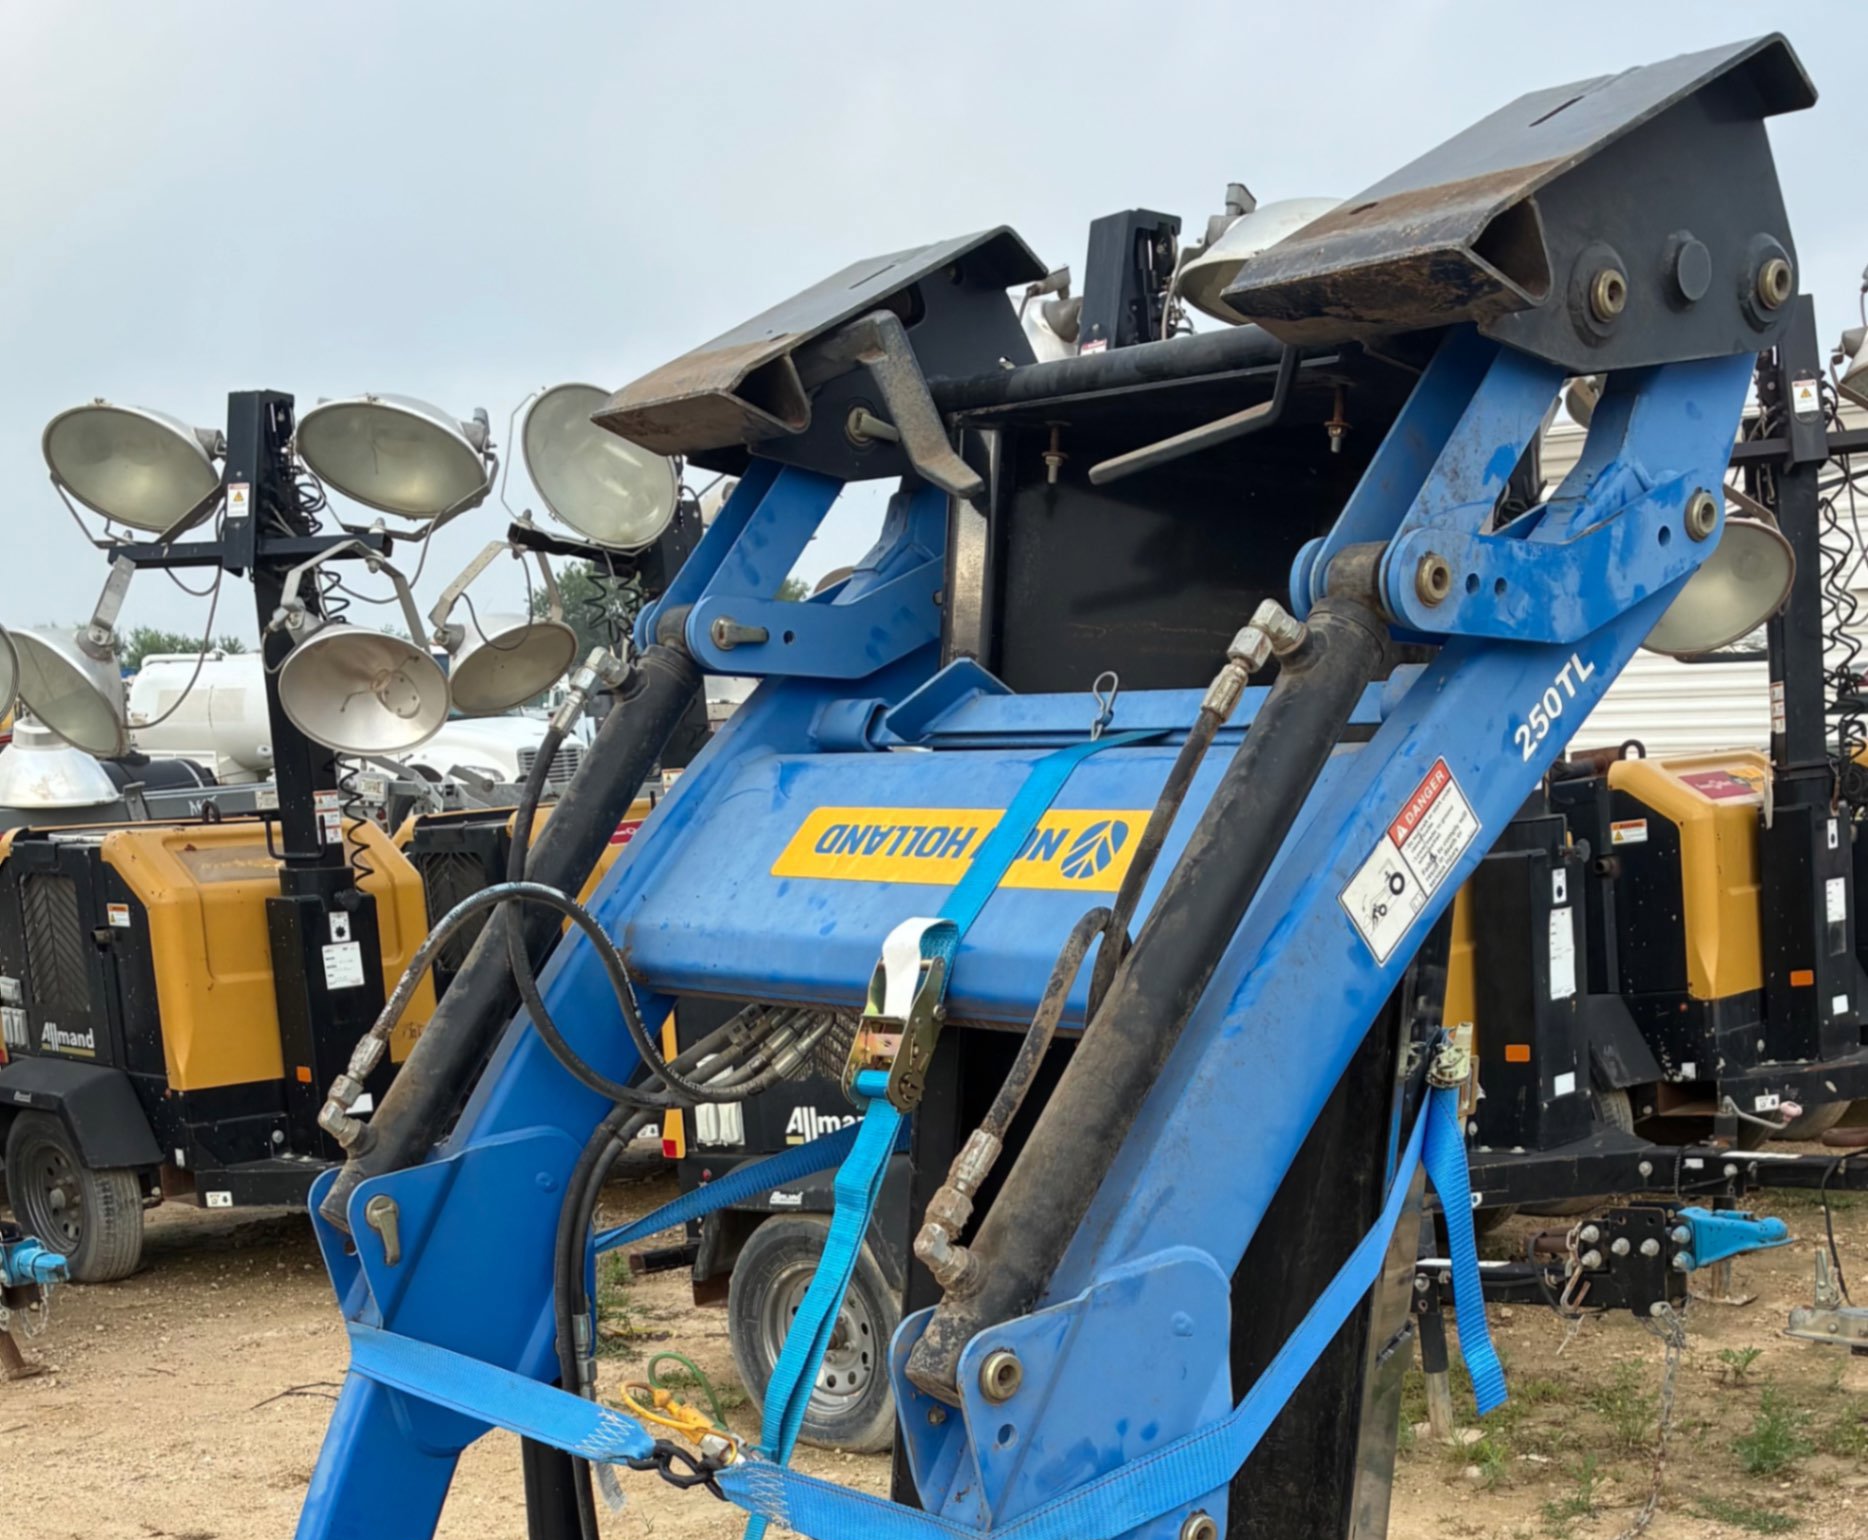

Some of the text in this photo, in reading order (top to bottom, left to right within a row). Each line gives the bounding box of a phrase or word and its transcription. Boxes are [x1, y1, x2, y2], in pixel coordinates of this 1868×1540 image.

[1514, 652, 1595, 762] 250TL
[1405, 770, 1446, 825] DANGER
[814, 823, 979, 859] HOLLAND
[41, 1021, 95, 1051] Allmand
[785, 1106, 866, 1143] Allma
